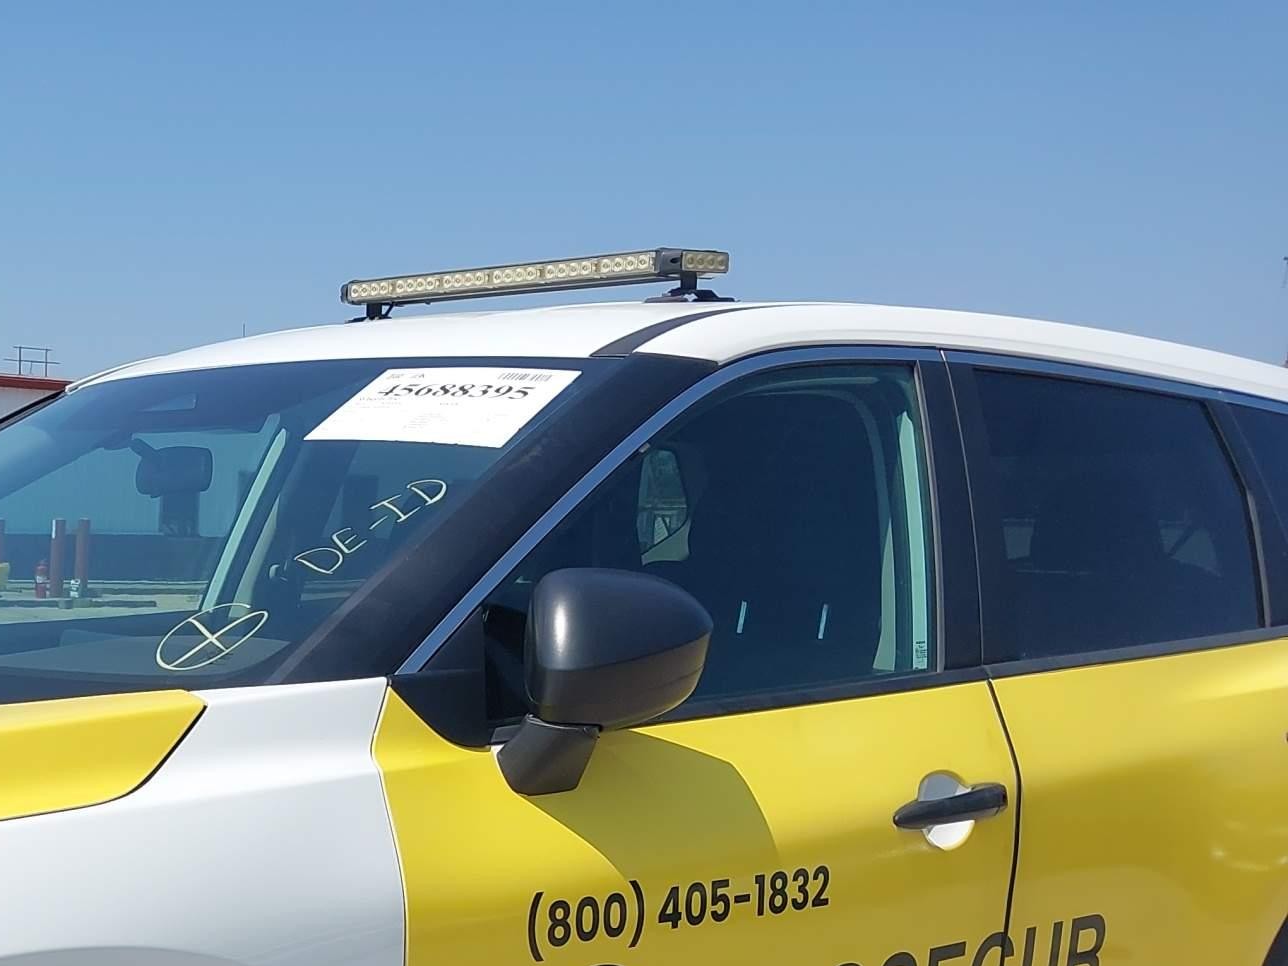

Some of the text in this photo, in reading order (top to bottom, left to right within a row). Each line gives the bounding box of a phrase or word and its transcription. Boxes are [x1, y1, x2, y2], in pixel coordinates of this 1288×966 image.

[378, 383, 536, 399] 45688395
[527, 864, 831, 962] (800) 405-1832
